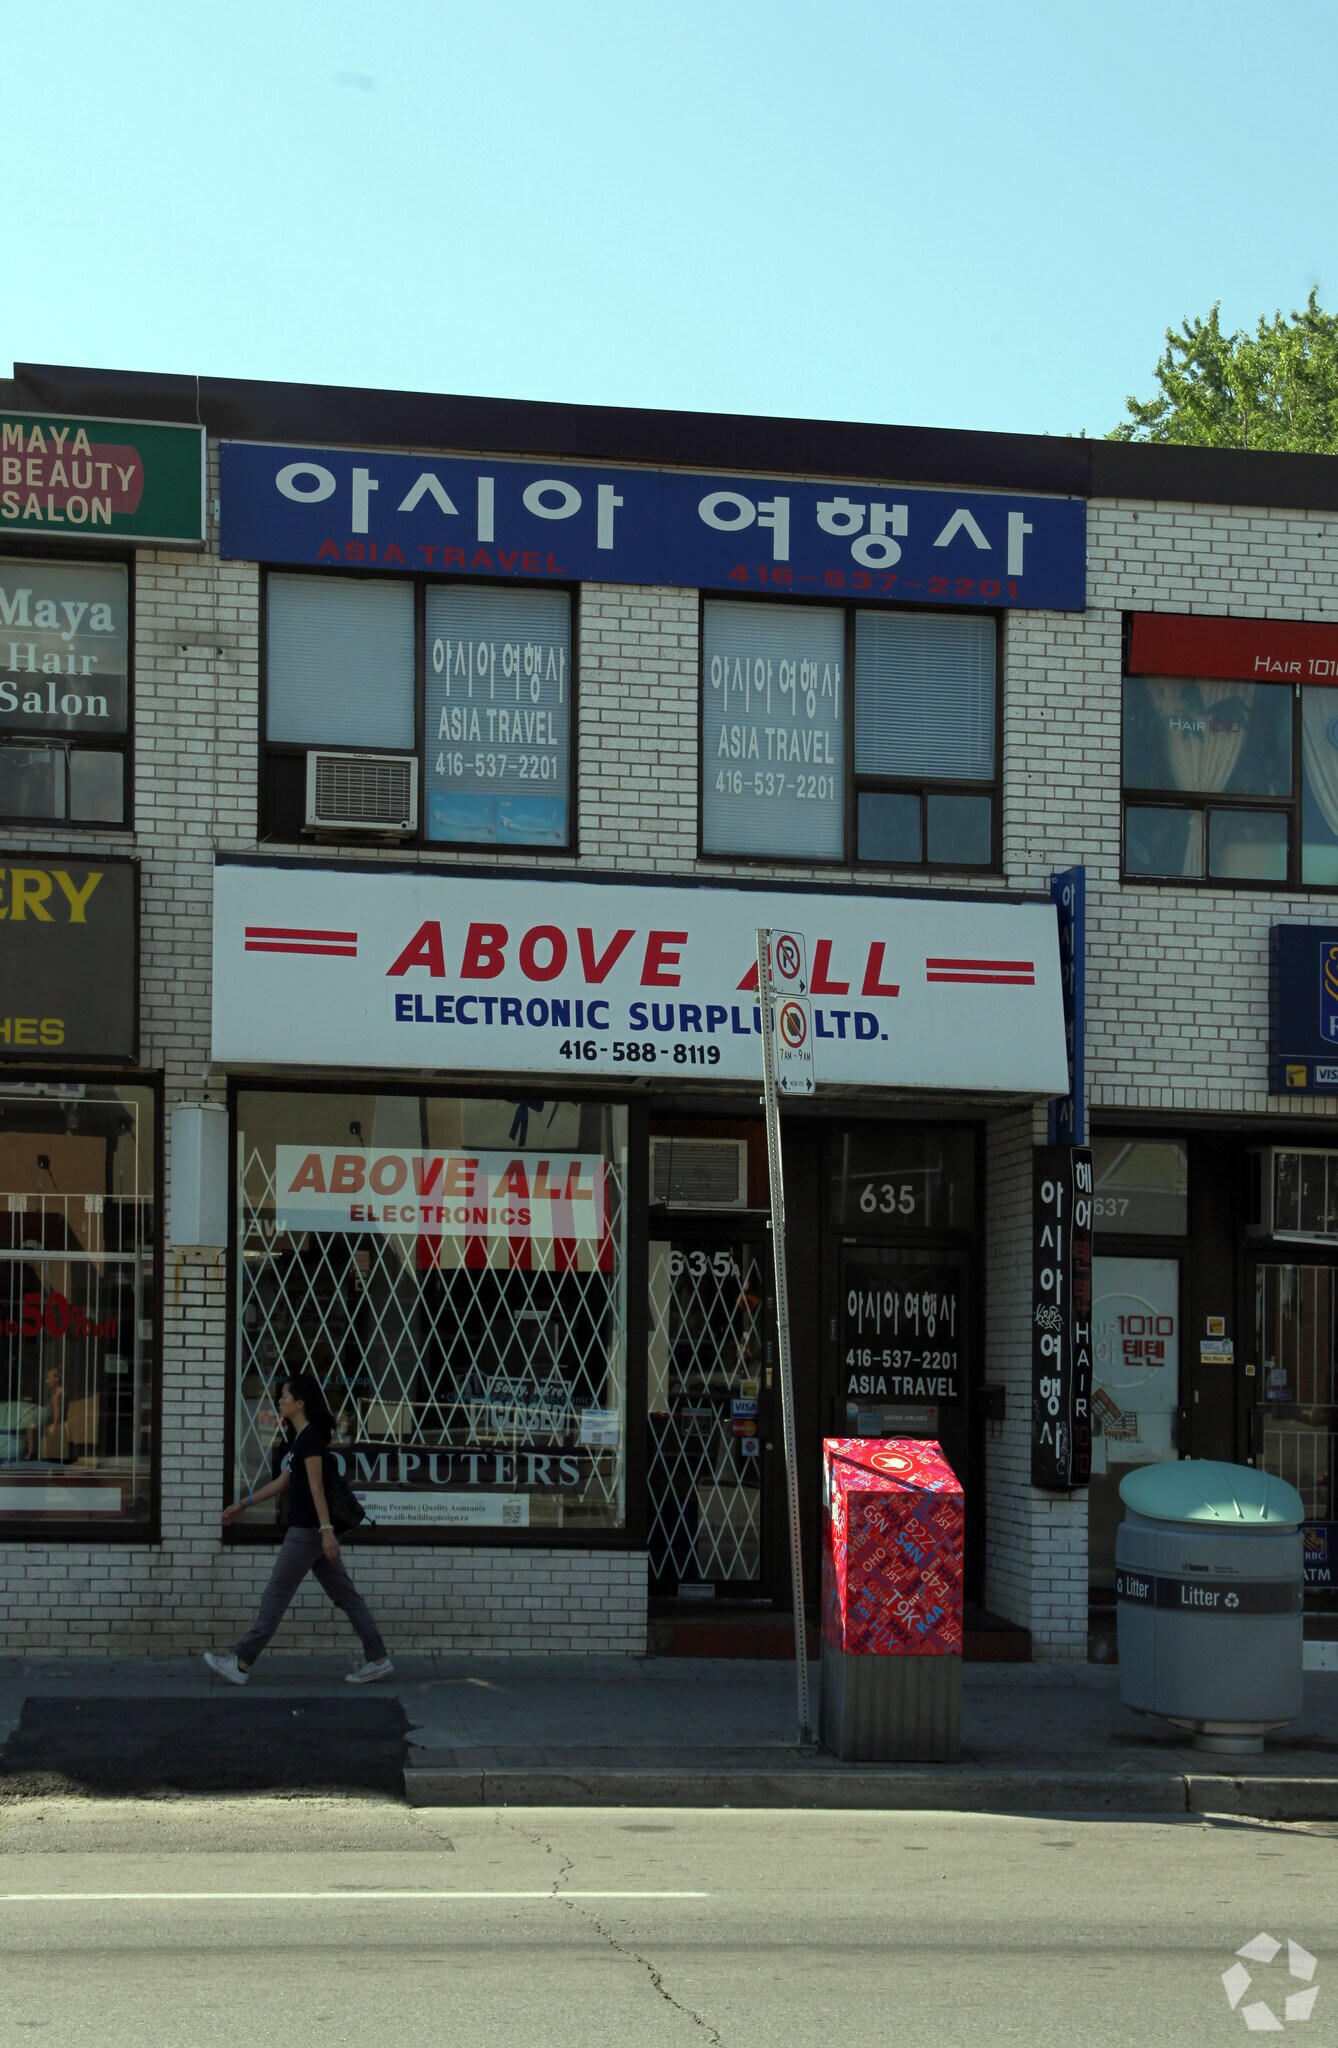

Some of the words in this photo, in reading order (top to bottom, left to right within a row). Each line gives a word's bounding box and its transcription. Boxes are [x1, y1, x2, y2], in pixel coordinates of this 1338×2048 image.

[2, 423, 92, 457] MAYA
[2, 457, 136, 492] BEAUTY
[1, 490, 112, 525] SALON
[275, 462, 624, 550] 아시아
[698, 491, 1033, 577] 여행사
[318, 539, 405, 565] ASIA
[419, 545, 566, 573] TRAVEL
[728, 564, 1019, 599] 416-537-2201
[0, 588, 115, 641] Maya
[8, 642, 98, 676] Hair
[433, 639, 496, 699] 아시아
[502, 642, 565, 704] 여행사
[0, 681, 110, 717] Salon
[711, 655, 772, 714] 아시아
[778, 659, 840, 719] 여행사
[438, 707, 481, 742] ASIA
[486, 709, 558, 745] TRAVEL
[718, 724, 760, 759] ASIA
[765, 727, 834, 764] TRAVEL
[435, 752, 558, 780] 416-537-2201
[715, 770, 835, 800] 416-537-2201
[385, 921, 688, 988] ABOVE
[395, 993, 610, 1030] ELECTRONIC
[629, 1001, 775, 1035] SURPLU
[815, 1008, 888, 1040] LTD.
[559, 1040, 721, 1065] 416-588-8119
[288, 1153, 479, 1198] ABOVE
[493, 1159, 594, 1200] ALL
[350, 1204, 531, 1226] ELECTRONICS
[860, 1183, 915, 1214] 635
[1094, 1197, 1130, 1216] 637
[847, 1289, 900, 1336] 아시아
[904, 1291, 957, 1338] 여행사
[1118, 1315, 1174, 1336] 1010
[845, 1348, 958, 1370] 416-537-2201
[1122, 1339, 1165, 1367] 텐텐
[847, 1375, 888, 1395] ASIA
[891, 1376, 958, 1397] TRAVEL
[735, 1402, 757, 1411] VISA
[281, 1452, 580, 1487] MPUTERS
[361, 1503, 388, 1512] uilding
[389, 1503, 417, 1512] Permits
[422, 1504, 448, 1513] Quality
[451, 1504, 487, 1512] Assurance
[864, 1505, 889, 1532] G5N
[894, 1531, 925, 1563] S4N
[904, 1517, 937, 1552] B2Z
[1304, 1551, 1325, 1560] RBC
[1126, 1576, 1149, 1599] Litter
[1181, 1584, 1221, 1607] Litter
[886, 1587, 922, 1630] T9K
[915, 1604, 946, 1635] K4A
[869, 1619, 900, 1652] H1X
